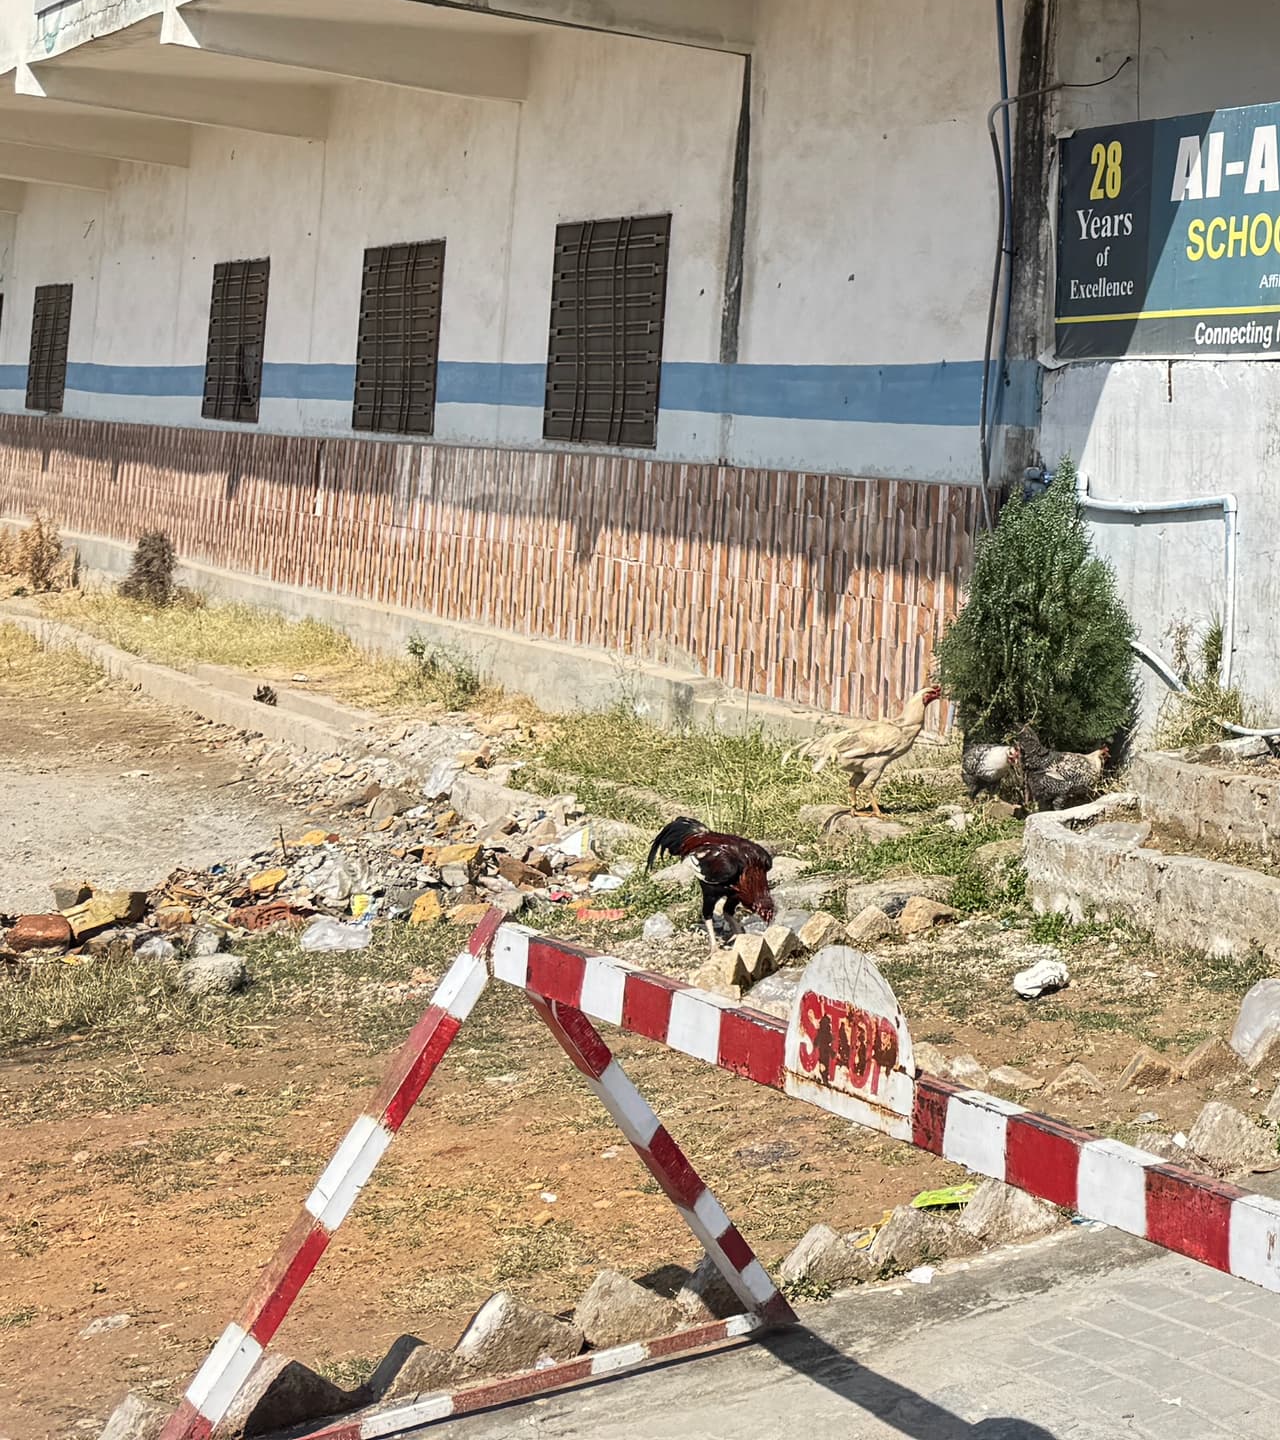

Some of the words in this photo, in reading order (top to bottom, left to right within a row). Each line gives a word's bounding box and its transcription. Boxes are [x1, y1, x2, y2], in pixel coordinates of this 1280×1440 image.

[1090, 141, 1122, 200] 28
[1076, 208, 1133, 240] Years
[1096, 246, 1110, 267] of
[1070, 277, 1134, 300] Excellence
[1194, 320, 1273, 349] Connecting
[799, 990, 900, 1096] STOP
